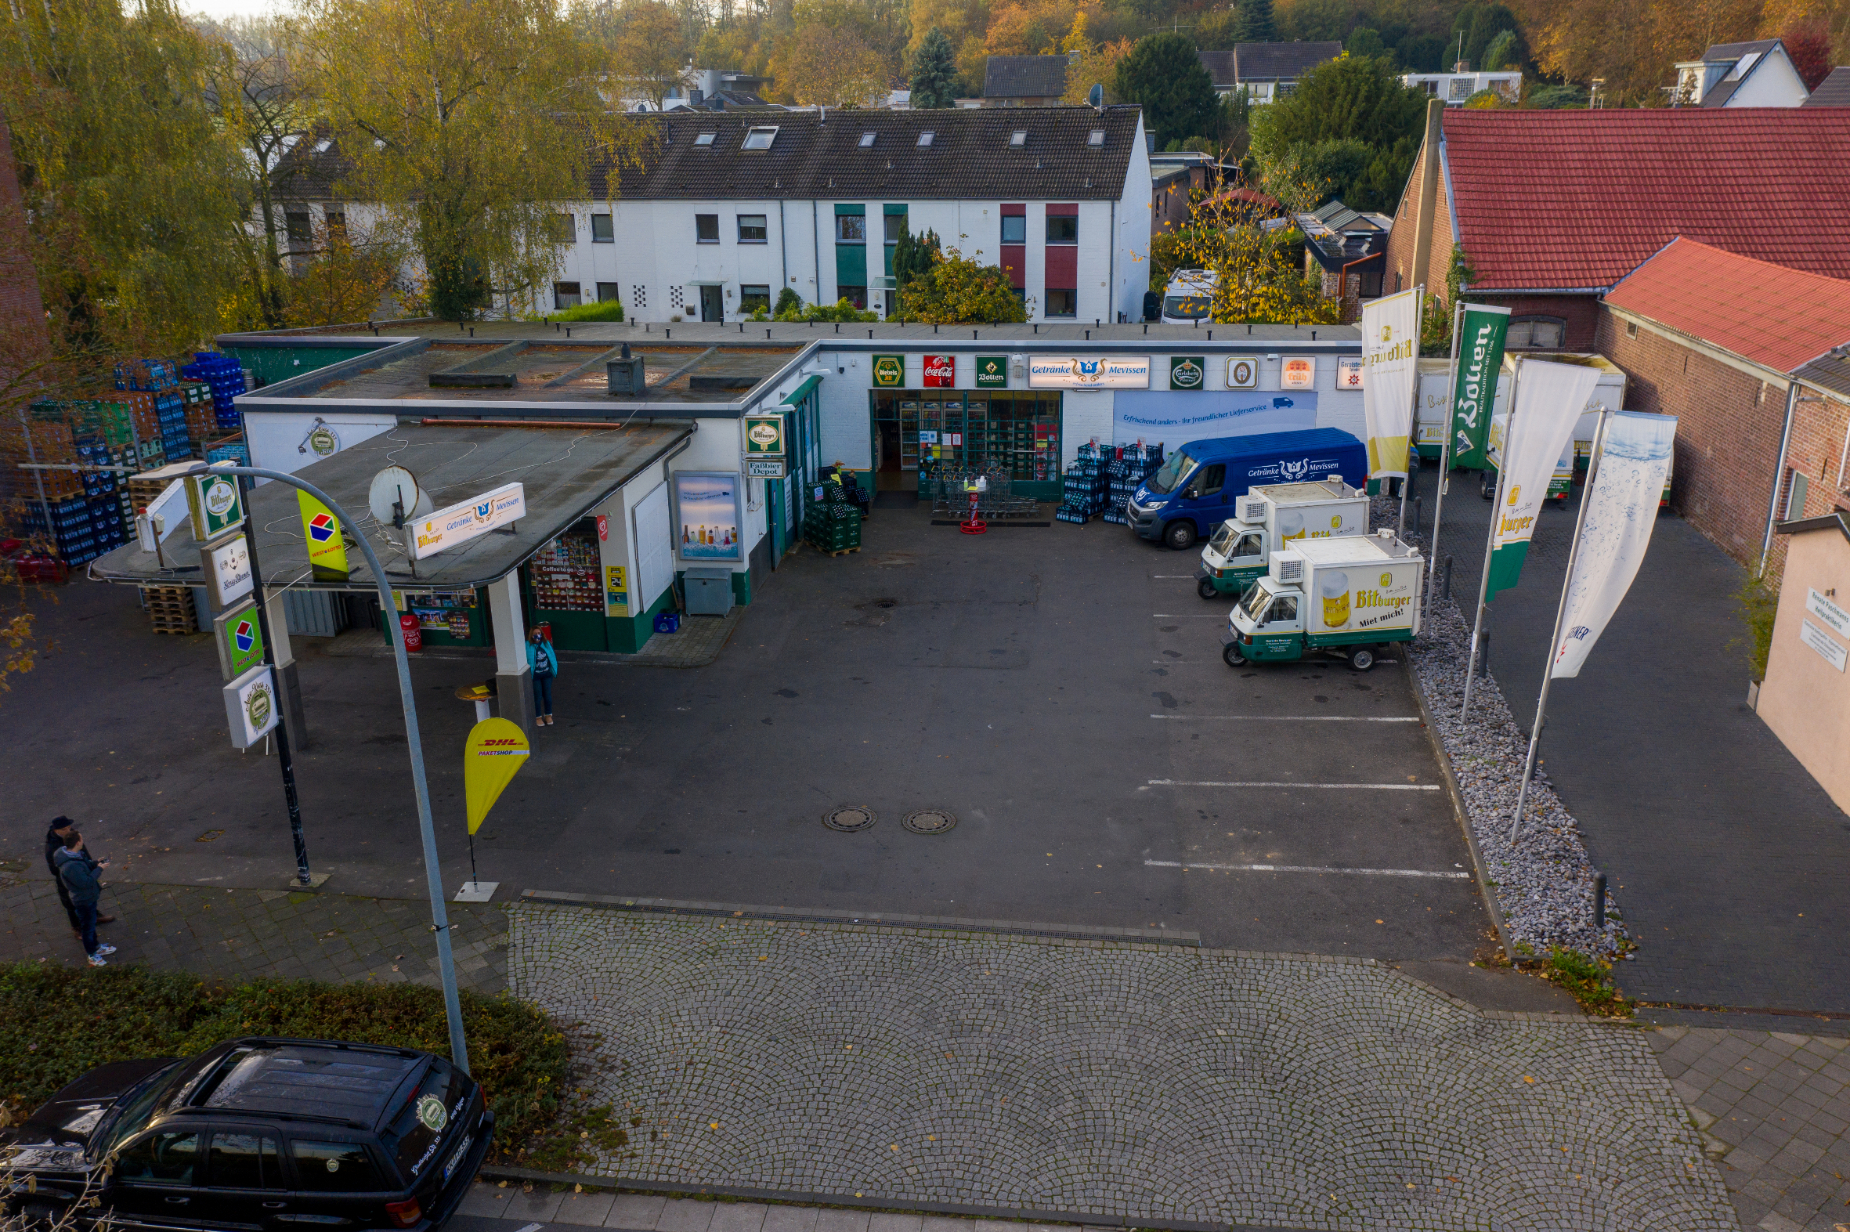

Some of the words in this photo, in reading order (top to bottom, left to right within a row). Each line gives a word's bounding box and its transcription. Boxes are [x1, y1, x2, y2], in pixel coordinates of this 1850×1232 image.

[1032, 365, 1071, 374] Getränke
[1108, 365, 1147, 374] Mevissen
[1458, 323, 1492, 429] Bolten
[1123, 414, 1157, 425] Erfrischend
[1157, 418, 1178, 426] anders
[1191, 411, 1229, 425] freundlicher
[1229, 404, 1267, 417] Lieferservice
[750, 462, 782, 470] Faßbier
[753, 468, 778, 476] Depot
[1248, 468, 1280, 477] Getränke
[1308, 462, 1339, 471] Mevissen
[446, 514, 473, 531] Getränke
[496, 497, 520, 511] Mevissen
[417, 533, 443, 549] Bitburger
[1355, 589, 1411, 609] Bitburger
[1359, 616, 1378, 628] Miet
[1379, 608, 1404, 621] mich!
